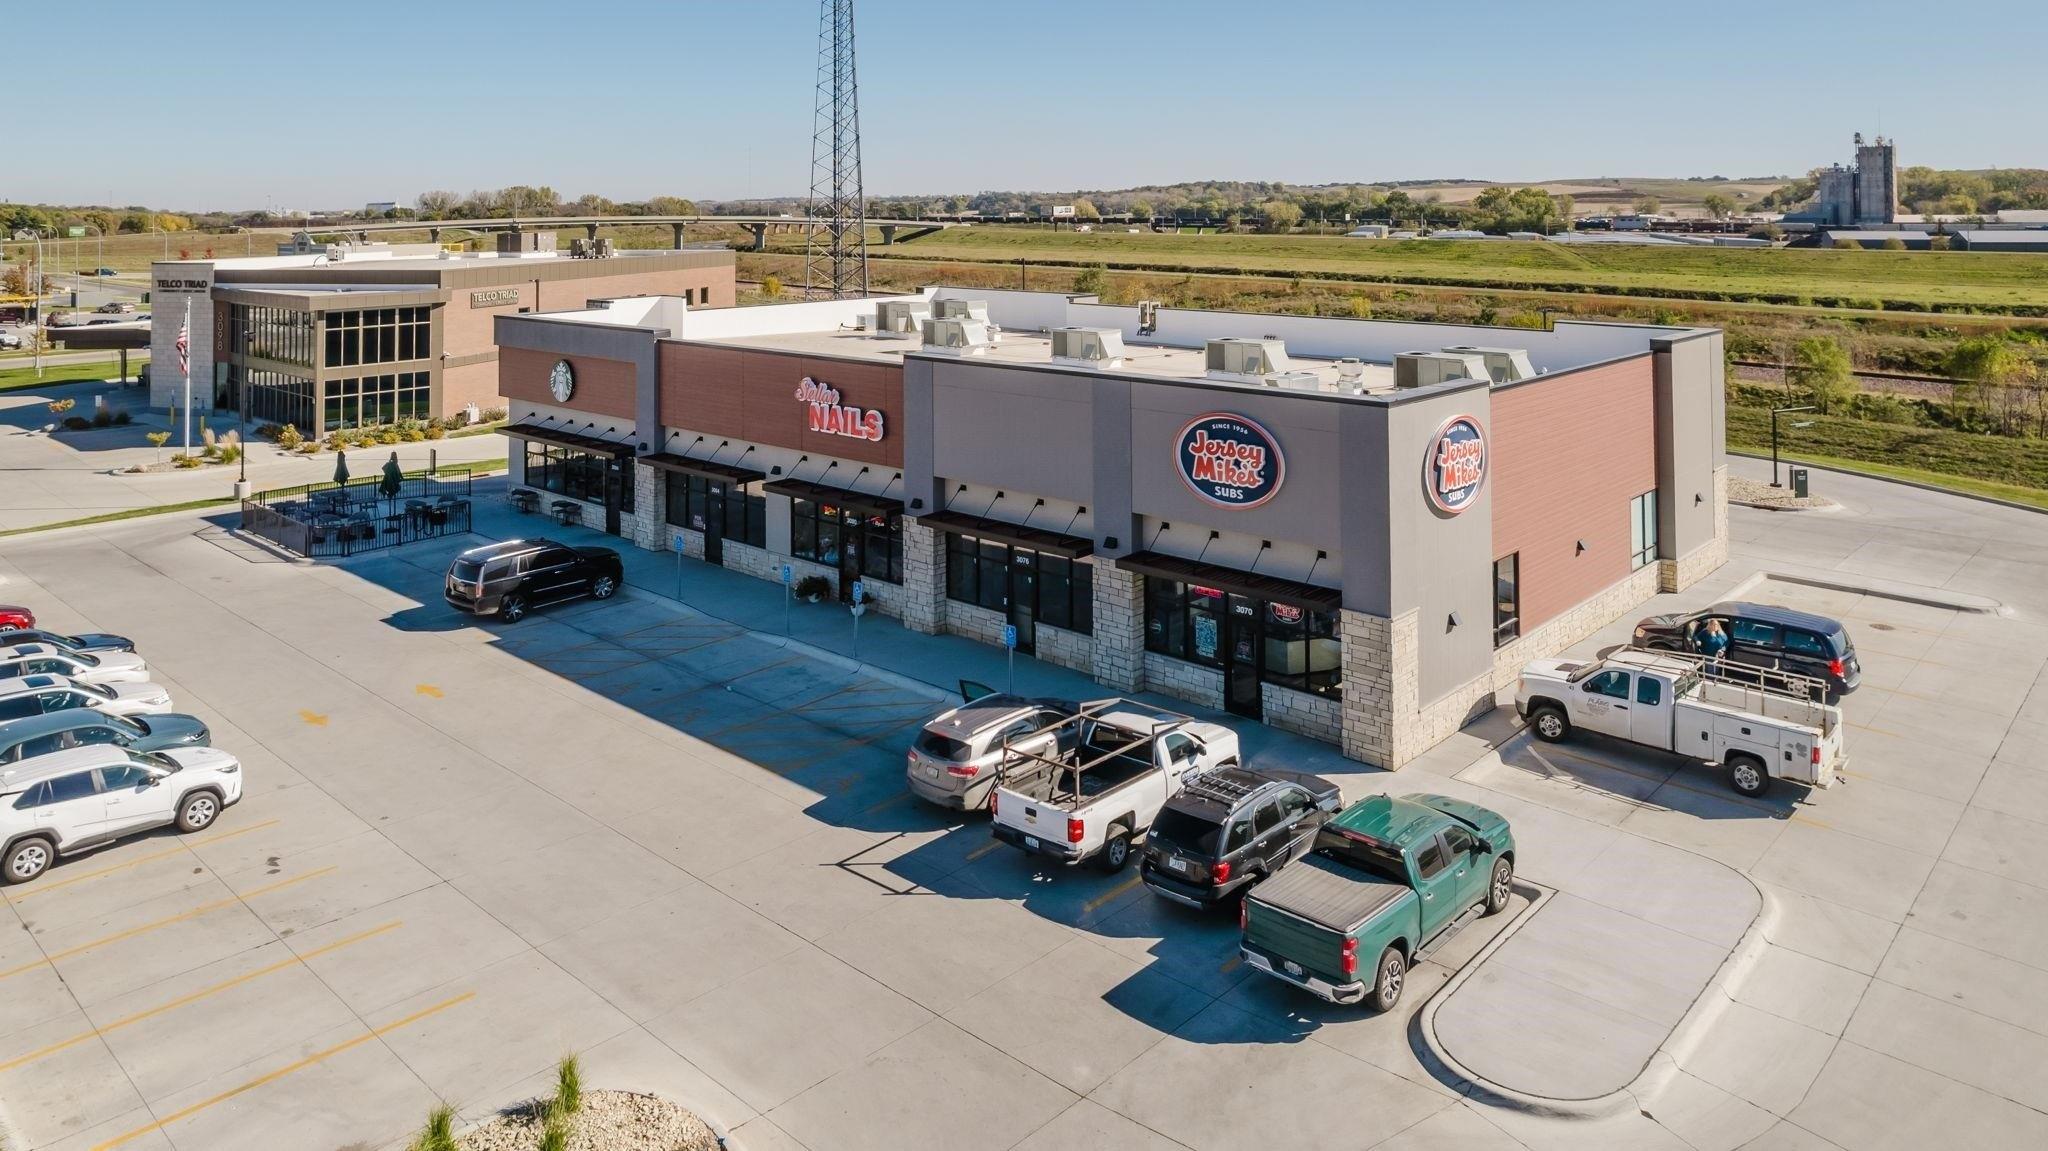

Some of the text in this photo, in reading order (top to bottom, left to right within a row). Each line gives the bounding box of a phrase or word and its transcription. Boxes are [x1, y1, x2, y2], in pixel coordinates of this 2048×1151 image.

[157, 280, 208, 288] TELCO TRIAD
[473, 290, 519, 302] TELCO TRIAD
[808, 402, 884, 441] NAILS
[1232, 425, 1248, 435] 1956
[1188, 430, 1265, 468] Jersey
[1437, 438, 1481, 466] Jersey
[1192, 455, 1264, 488] Mike's
[1214, 486, 1244, 499] SUBS
[1448, 489, 1465, 503] SUBS
[1016, 555, 1030, 565] 3076
[1235, 605, 1253, 616] 3070
